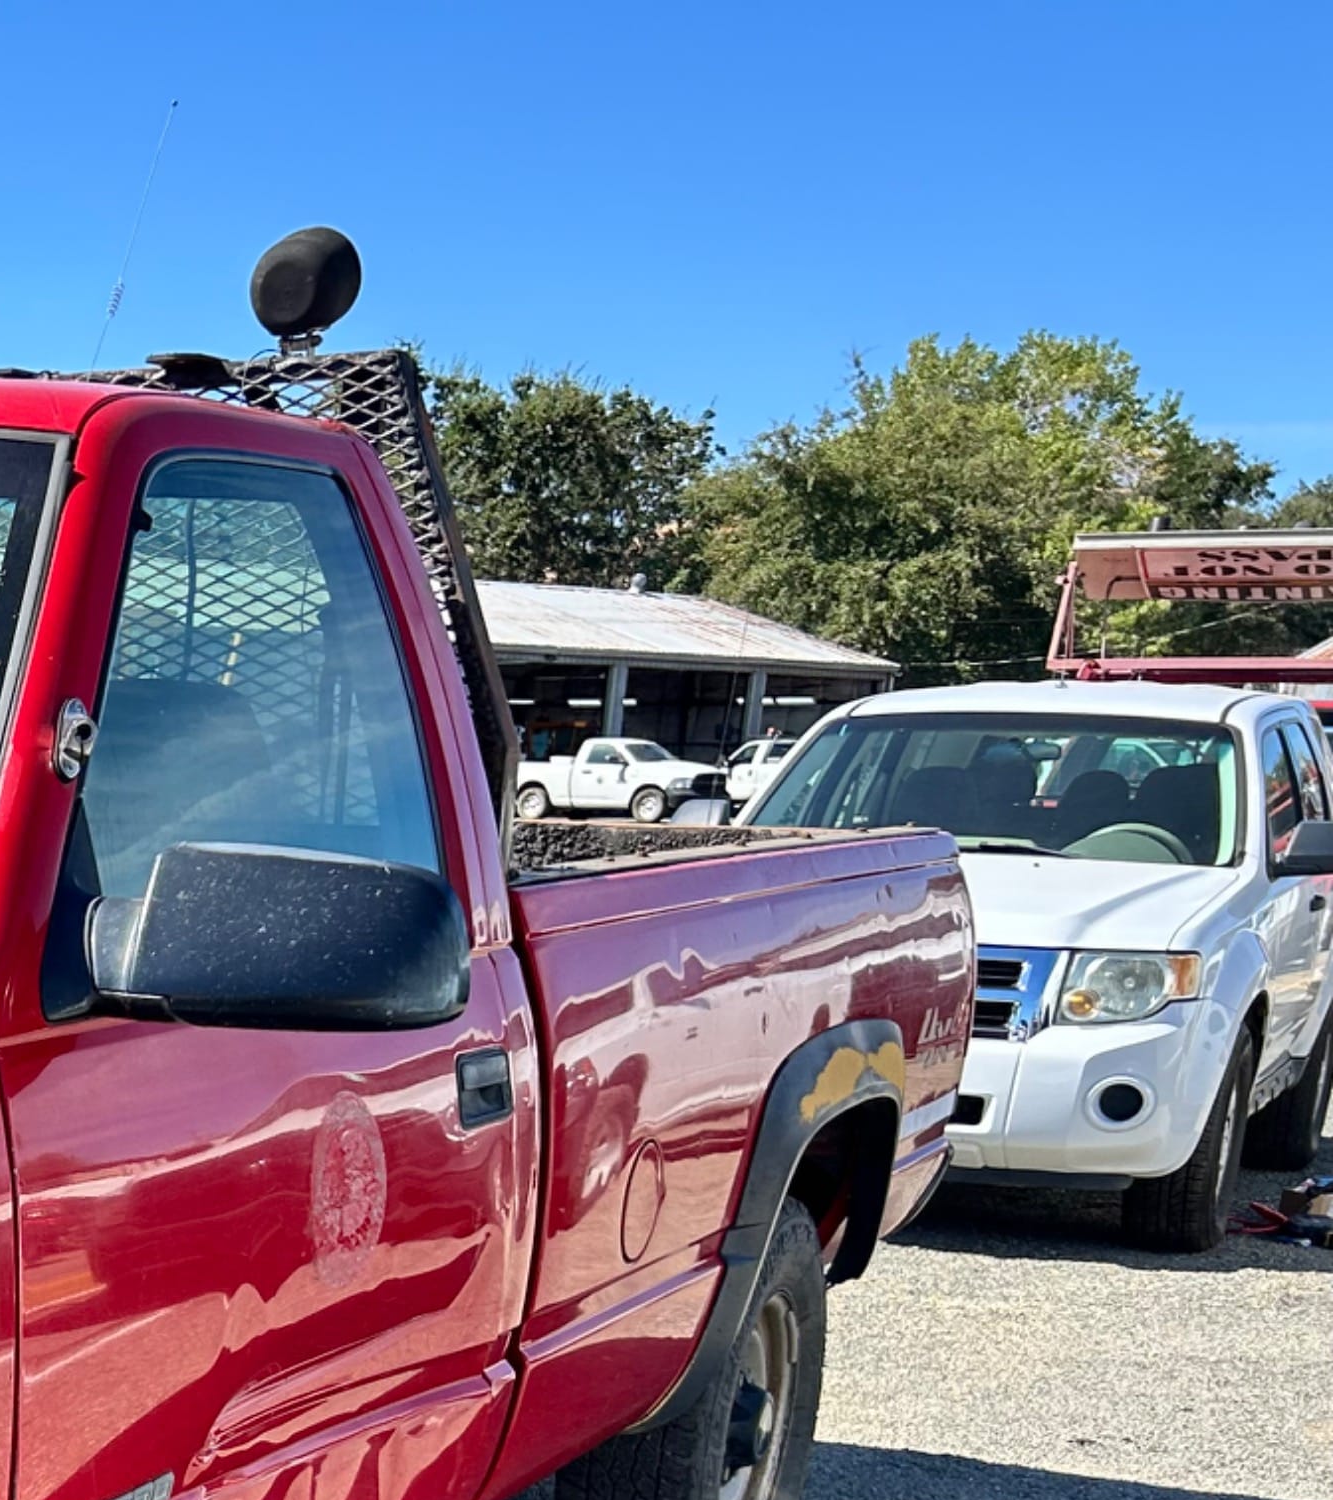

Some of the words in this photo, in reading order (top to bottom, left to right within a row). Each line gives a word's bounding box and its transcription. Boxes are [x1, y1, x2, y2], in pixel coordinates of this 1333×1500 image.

[1196, 549, 1333, 564] PASS
[1164, 564, 1274, 577] NOT
[1157, 586, 1333, 600] INTING
